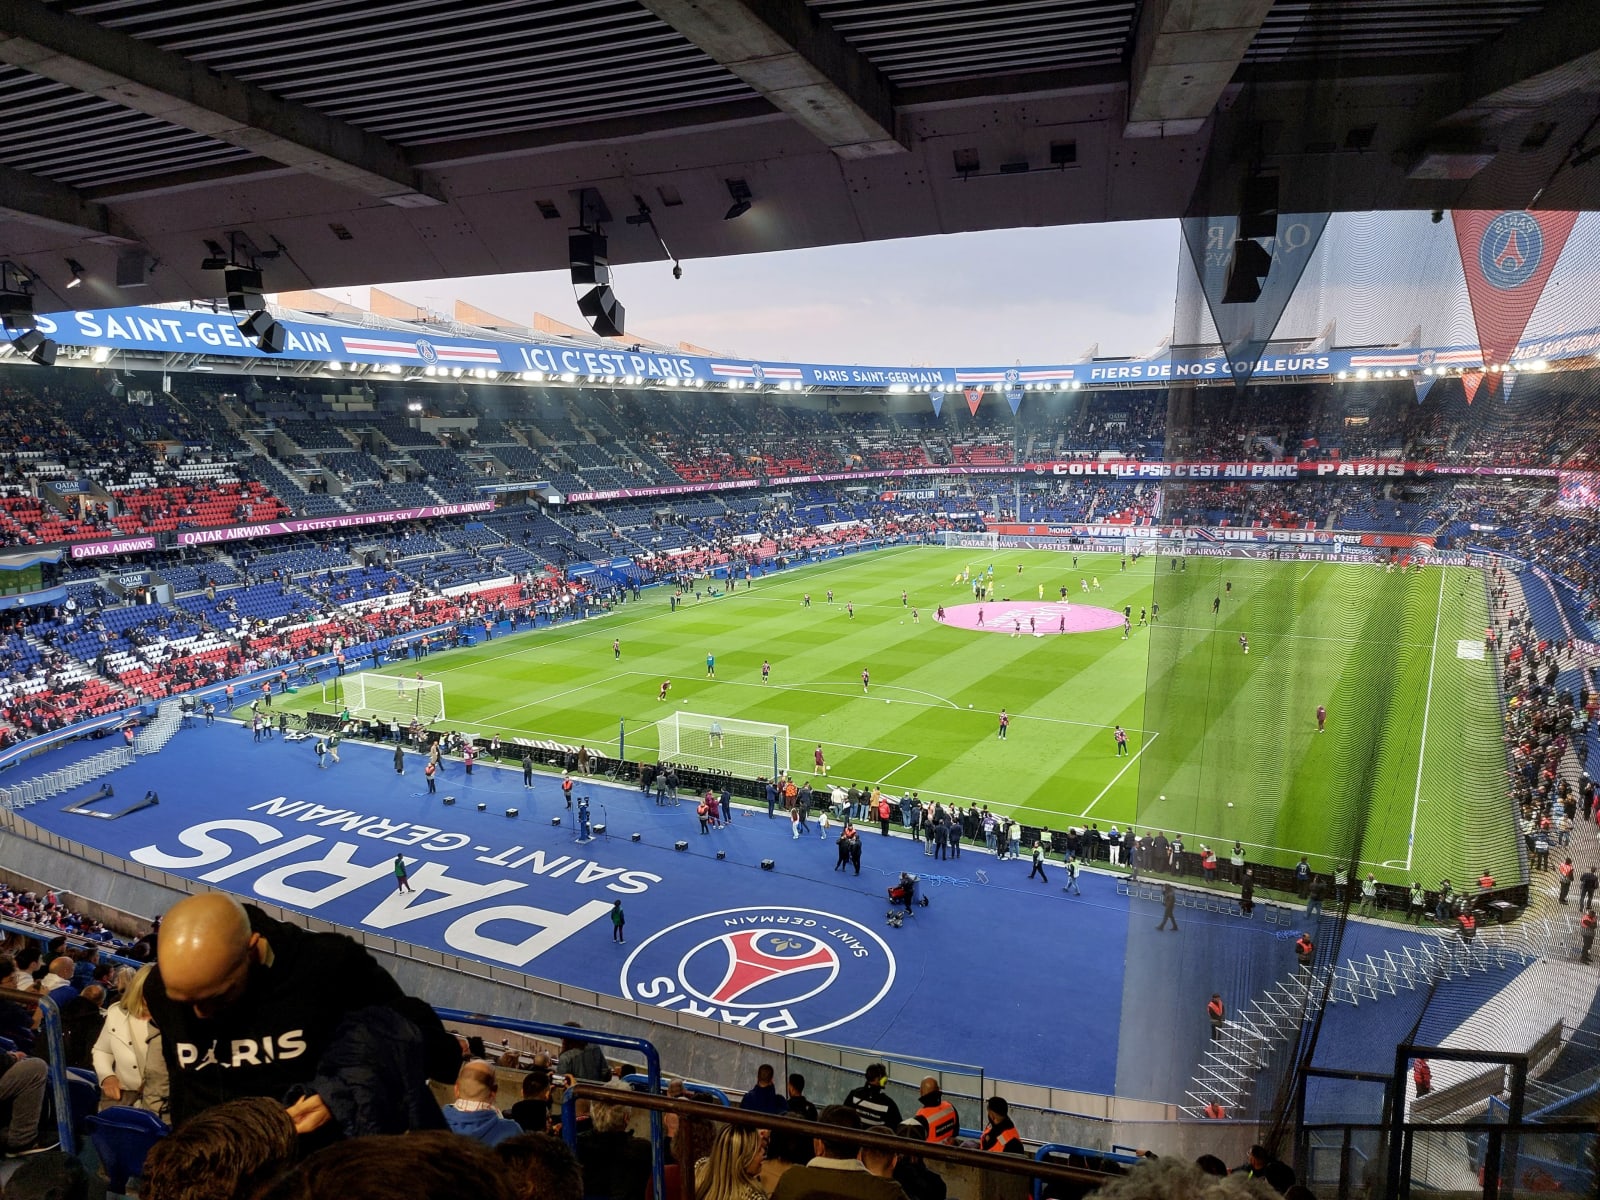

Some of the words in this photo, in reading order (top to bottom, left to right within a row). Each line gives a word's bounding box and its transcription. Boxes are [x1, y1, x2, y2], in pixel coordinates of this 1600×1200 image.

[520, 348, 558, 371] ICI
[562, 351, 626, 375] C'EST
[630, 356, 695, 378] PARIS
[1091, 366, 1142, 379] FIERS
[1147, 365, 1170, 377] DE
[1176, 362, 1216, 375] NOS
[1221, 357, 1330, 374] COULEURS
[813, 369, 849, 382] PARIS
[852, 370, 943, 383] SAINT-GERMAIN
[1119, 465, 1135, 476] LE
[1140, 465, 1171, 477] PSG
[1174, 464, 1220, 477] C'EST
[1224, 464, 1248, 477] AU
[1252, 464, 1298, 477] PARC
[1317, 463, 1405, 476] PARIS
[55, 482, 80, 490] QATAR
[717, 481, 735, 489] QATAR
[736, 479, 757, 488] AIRWAYS
[774, 477, 790, 485] QATAR
[572, 493, 593, 502] QATAR
[594, 490, 620, 500] AIRWAYS
[432, 505, 459, 516] QATAR
[461, 502, 491, 513] AIRWAYS
[297, 519, 338, 531] FASTEST
[366, 515, 376, 525] IN
[377, 513, 396, 523] THE
[185, 530, 222, 545] QATAR
[226, 525, 271, 539] AIRWAYS
[1087, 526, 1162, 538] VIRAGE
[1170, 529, 1258, 541] AUEUIL
[1267, 531, 1315, 542] 1991
[74, 545, 109, 558] QATAR
[112, 539, 154, 553] AIRWAYS
[960, 540, 985, 548] QATAR
[1038, 543, 1071, 551] FASTEST
[1106, 545, 1122, 553] THE
[1298, 552, 1324, 560] WI-FI
[120, 575, 142, 585] QATAR
[130, 819, 619, 967] PARIS
